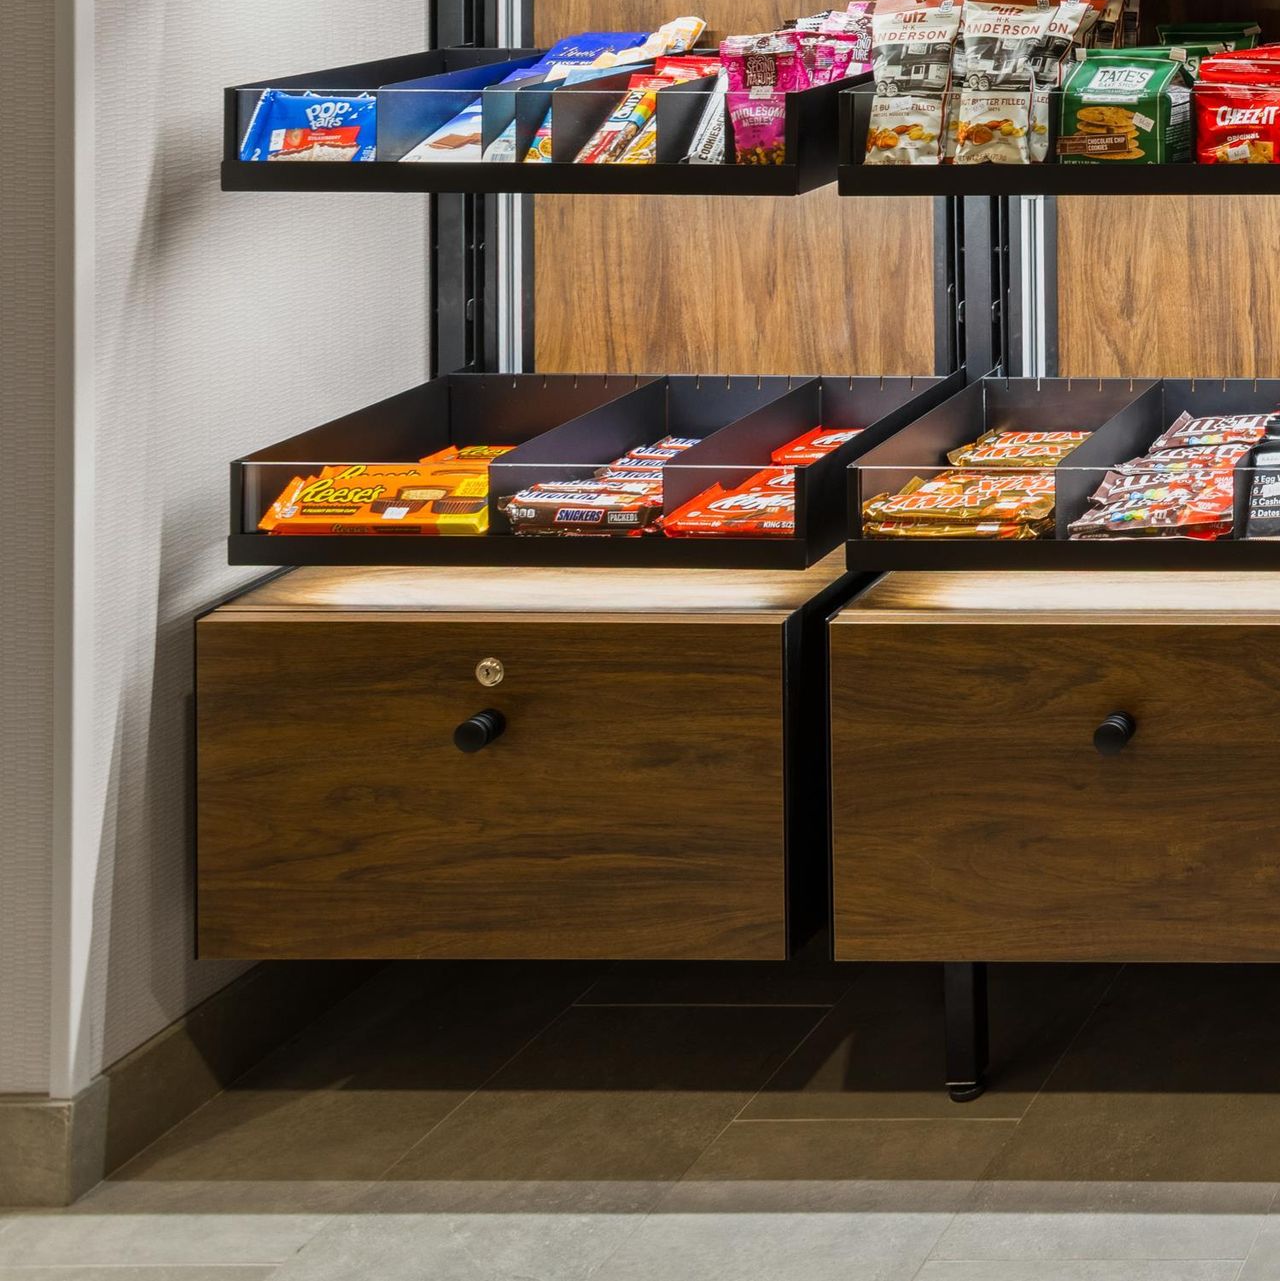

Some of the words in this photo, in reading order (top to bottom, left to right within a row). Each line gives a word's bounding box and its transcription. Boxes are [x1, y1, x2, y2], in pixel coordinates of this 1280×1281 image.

[1099, 66, 1153, 83] TATE'S
[1001, 98, 1026, 106] FILLED
[911, 103, 936, 112] FILLED
[1087, 137, 1112, 145] CHOCOLATE
[1114, 136, 1125, 144] CHIP
[1227, 134, 1260, 142] ORIGINAL
[1261, 475, 1275, 485] Egg
[557, 510, 602, 522] SNICKERS
[1257, 509, 1280, 517] Dates
